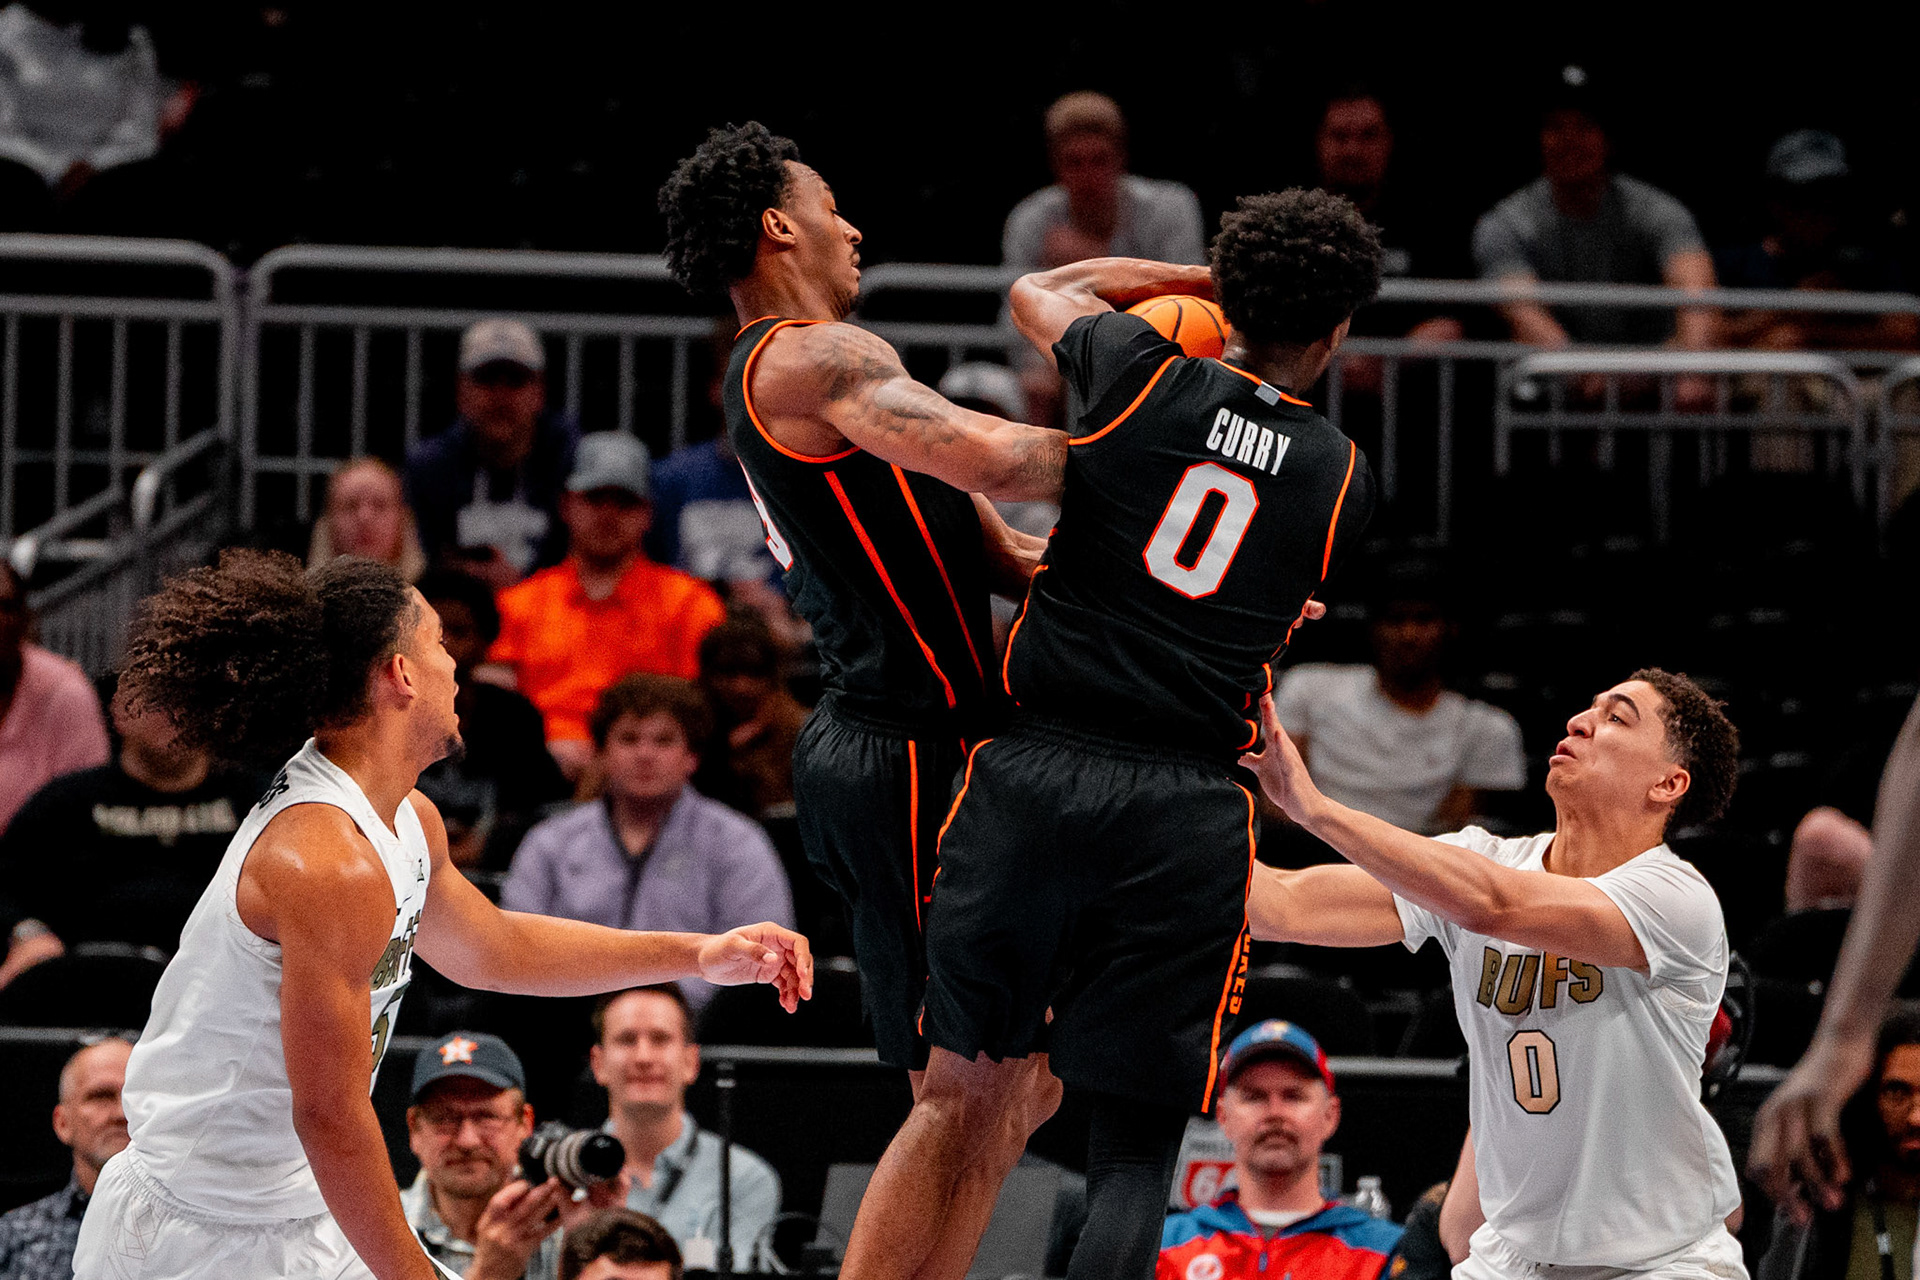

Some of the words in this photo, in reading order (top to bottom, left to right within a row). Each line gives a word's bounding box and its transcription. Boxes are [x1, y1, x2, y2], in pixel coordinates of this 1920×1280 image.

[1206, 407, 1291, 476] CURRY
[1142, 461, 1260, 600] 0
[1507, 1029, 1561, 1114] 0
